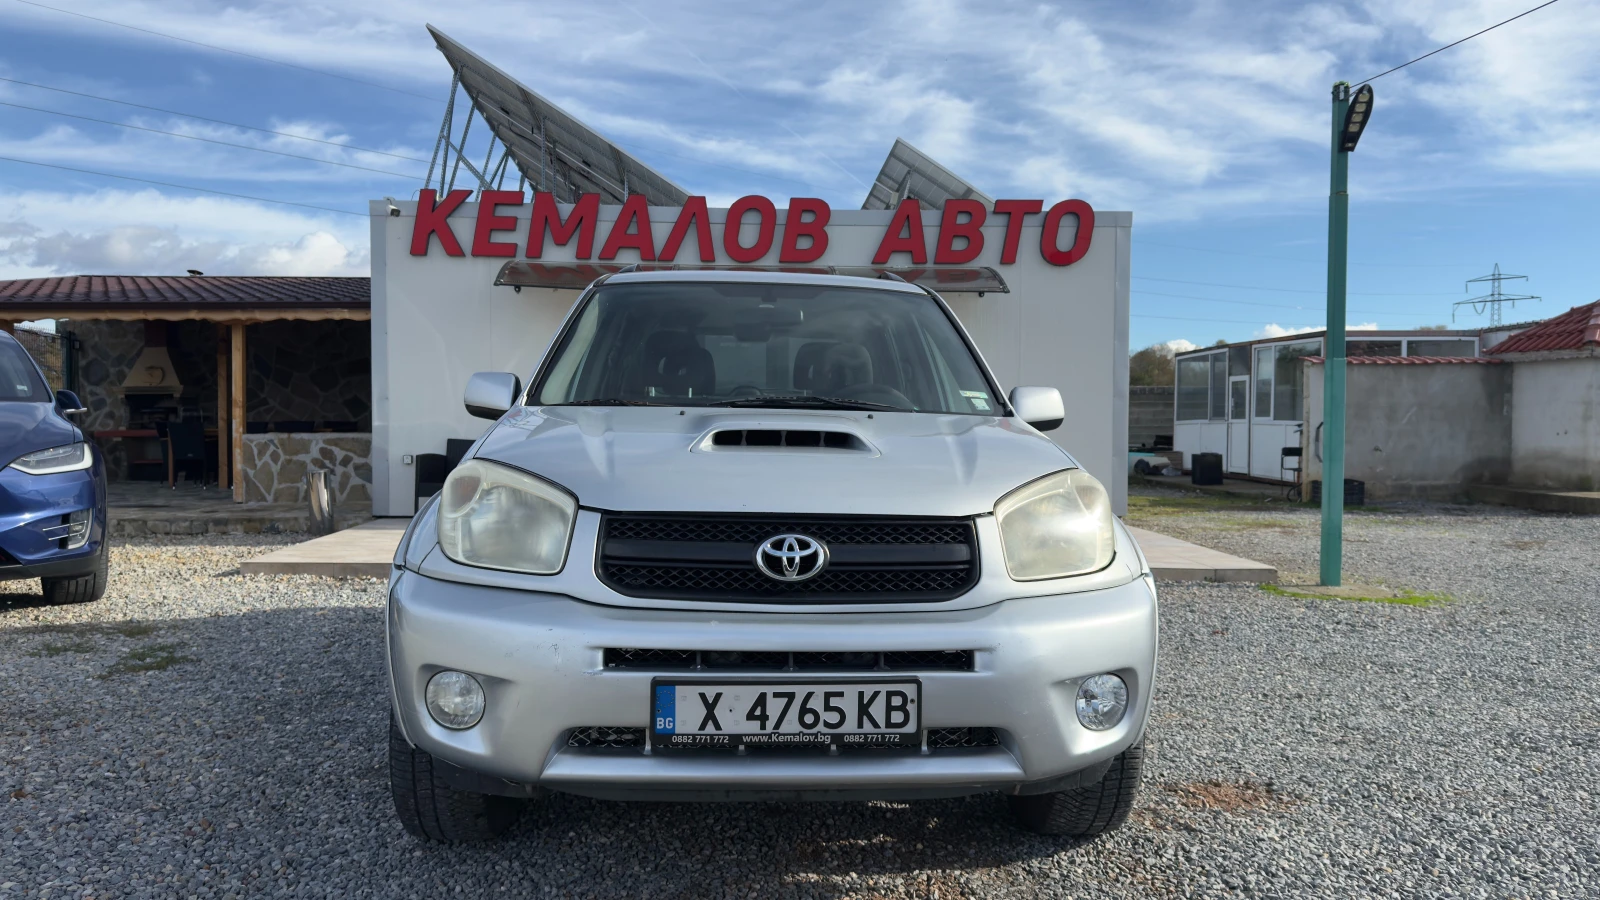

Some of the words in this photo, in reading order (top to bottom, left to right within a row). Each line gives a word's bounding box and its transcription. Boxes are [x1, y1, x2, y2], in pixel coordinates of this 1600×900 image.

[409, 188, 832, 265] КЕМАЛОВ
[872, 198, 1096, 268] АВТО
[697, 692, 724, 731] X
[745, 691, 847, 731] 4765
[857, 690, 911, 730] KB
[656, 718, 674, 729] BG
[672, 735, 693, 743] 0882
[695, 735, 711, 743] 771
[713, 735, 729, 743] 772
[742, 733, 831, 744] www.Kemalov.bg
[844, 734, 864, 743] 0882
[865, 734, 882, 742] 771
[884, 733, 900, 742] 772
